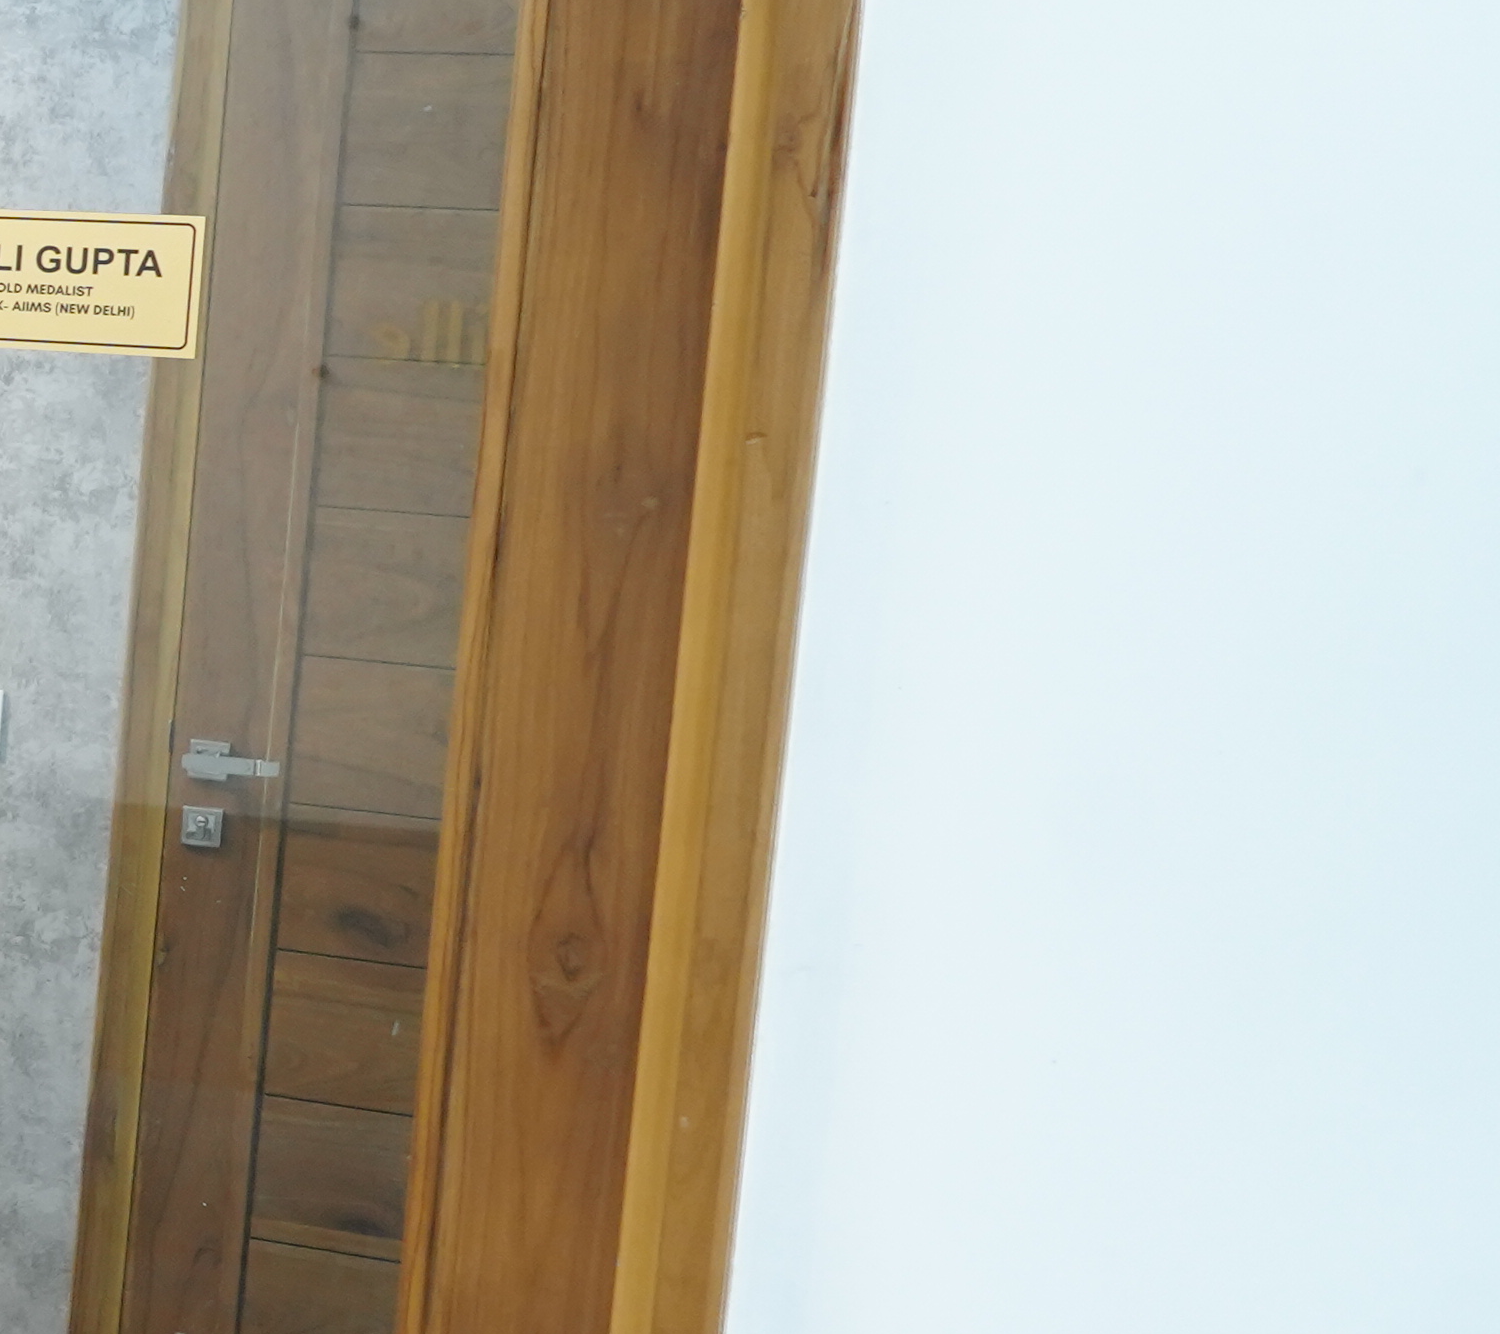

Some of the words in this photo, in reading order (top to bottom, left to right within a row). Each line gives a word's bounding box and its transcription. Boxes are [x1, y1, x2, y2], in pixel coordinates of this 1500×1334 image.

[36, 245, 163, 277] GUPTA
[25, 283, 94, 297] MEDALIST
[11, 301, 52, 314] AIIMS
[55, 301, 89, 316] (NEW
[93, 303, 135, 320] DELHI)
